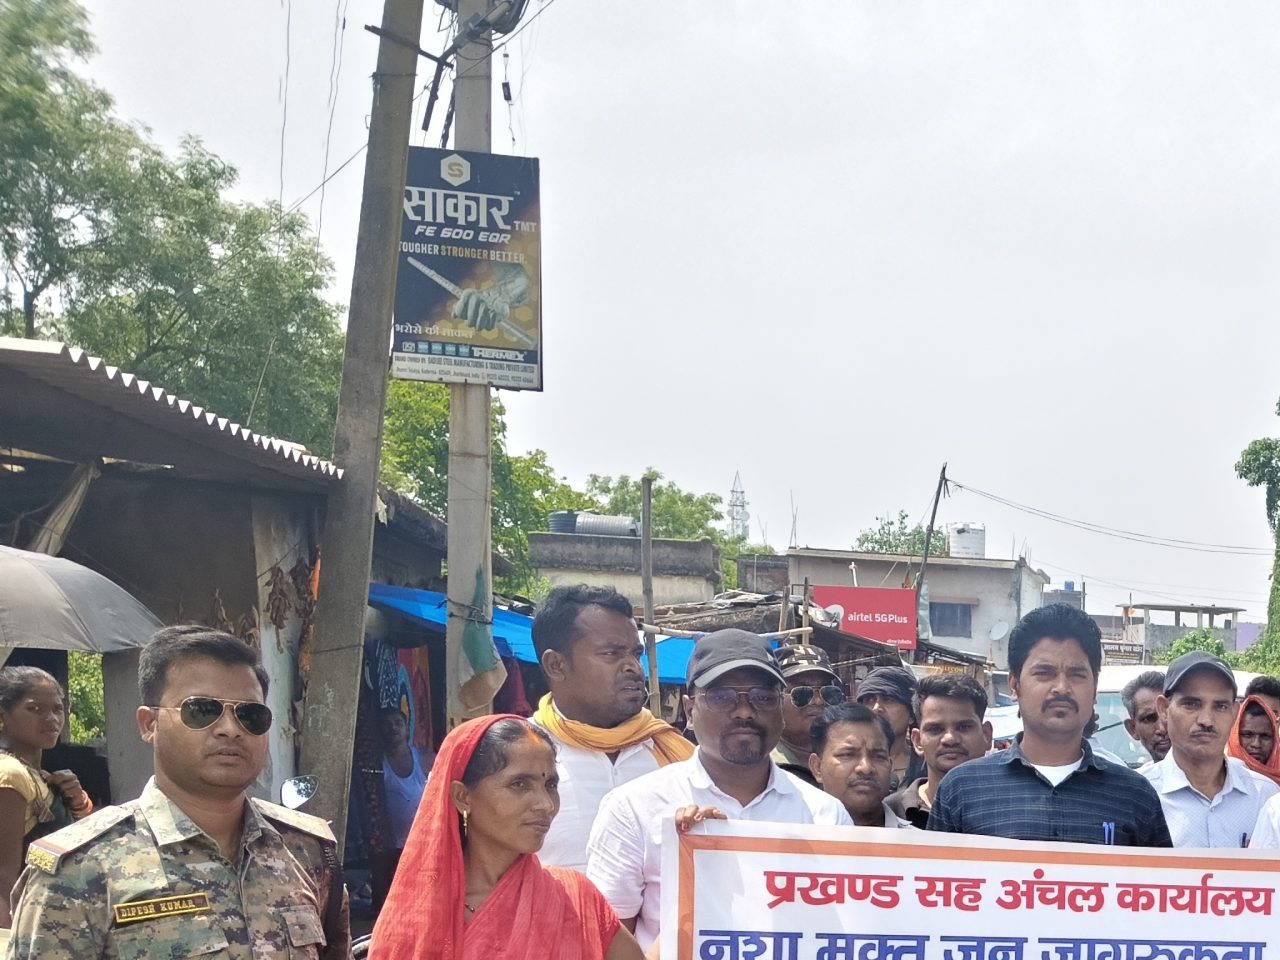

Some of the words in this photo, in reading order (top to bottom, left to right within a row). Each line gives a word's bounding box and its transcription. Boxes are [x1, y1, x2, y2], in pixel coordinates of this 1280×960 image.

[403, 186, 514, 230] साकार
[415, 225, 437, 237] FE
[440, 226, 474, 241] 600
[513, 220, 537, 233] TMT
[399, 241, 439, 255] TOUGHER
[440, 246, 488, 260] STRONGER
[395, 322, 422, 335] भरोसे
[425, 324, 439, 336] की
[848, 612, 872, 622] airtel
[764, 871, 903, 909] प्रखण्ड
[915, 876, 986, 911] सह
[996, 868, 1109, 913] अंचल
[1116, 873, 1276, 916] कार्यालय
[120, 903, 155, 917] DIPESH
[160, 899, 196, 912] KUMAR
